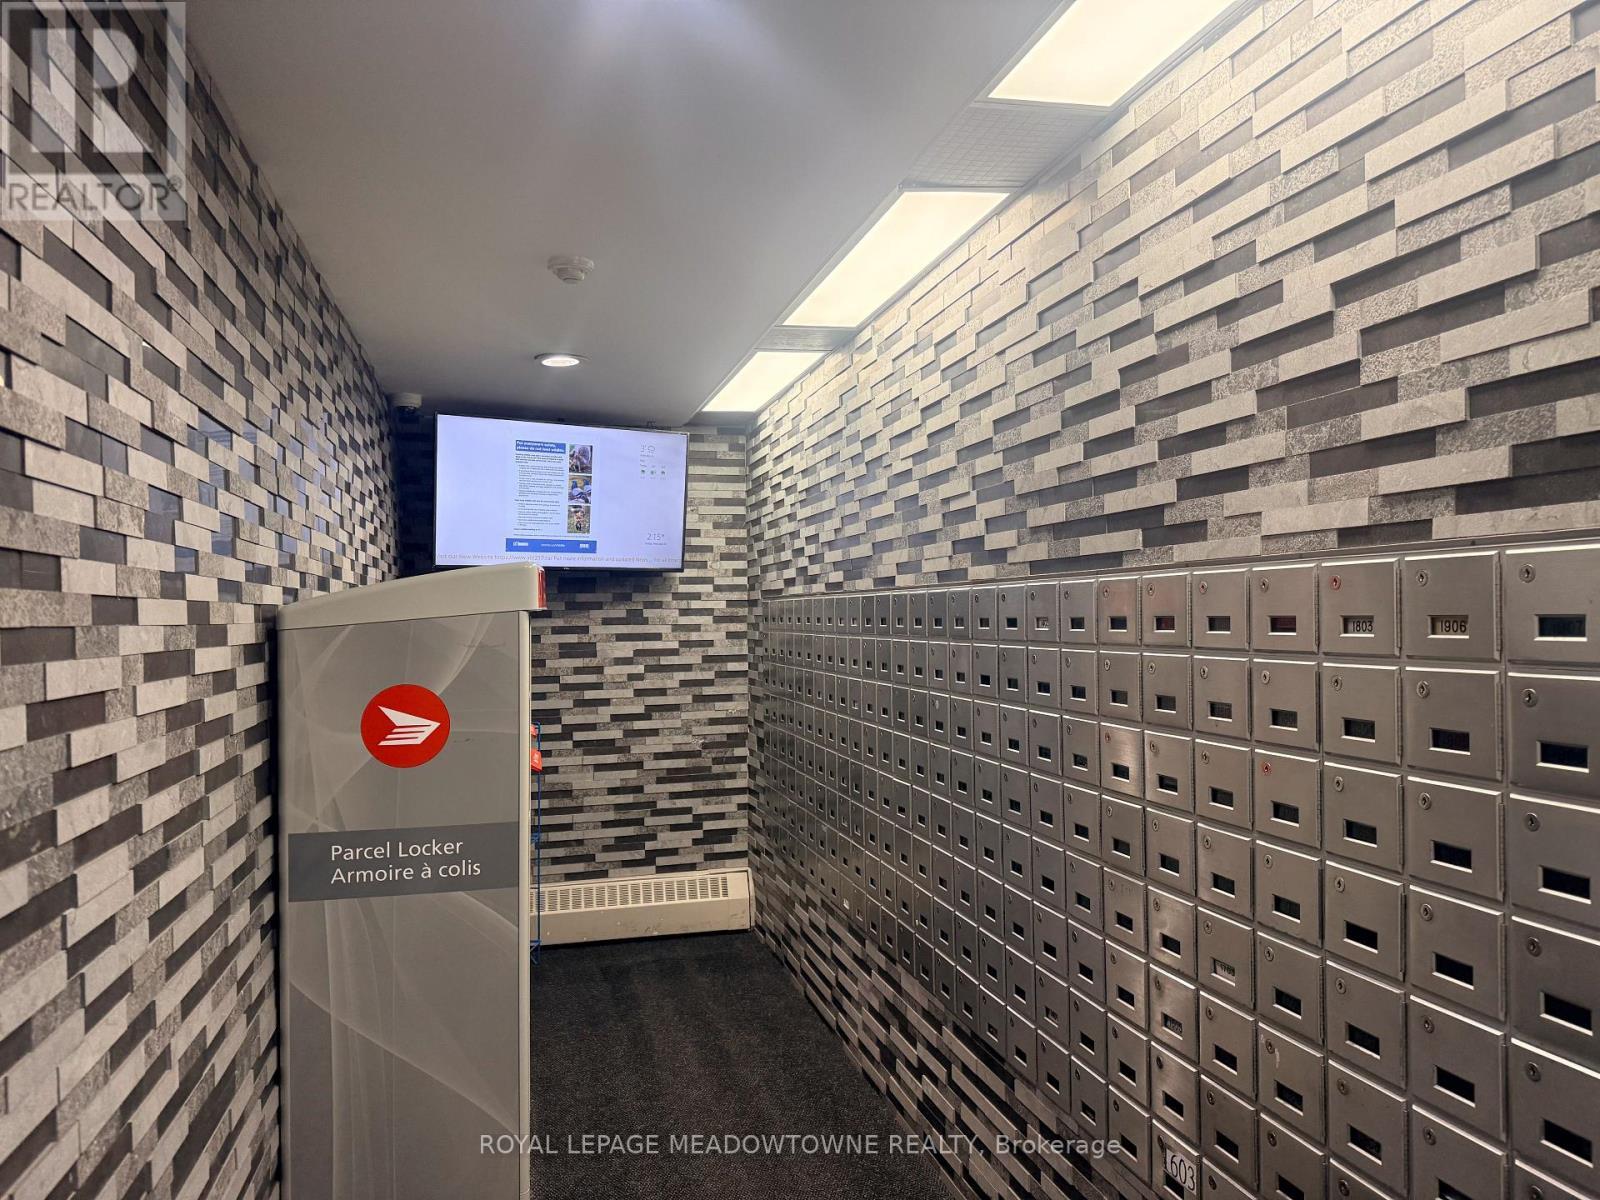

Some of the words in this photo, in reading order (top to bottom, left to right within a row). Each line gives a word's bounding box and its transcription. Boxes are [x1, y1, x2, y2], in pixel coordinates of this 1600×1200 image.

[1352, 620, 1374, 632] 1803
[1439, 620, 1467, 633] 1906
[331, 842, 390, 861] Parcel
[399, 839, 464, 857] Locker
[330, 865, 415, 884] Armoire
[421, 863, 432, 879] à
[439, 860, 481, 878] colis
[1170, 1155, 1196, 1191] 603
